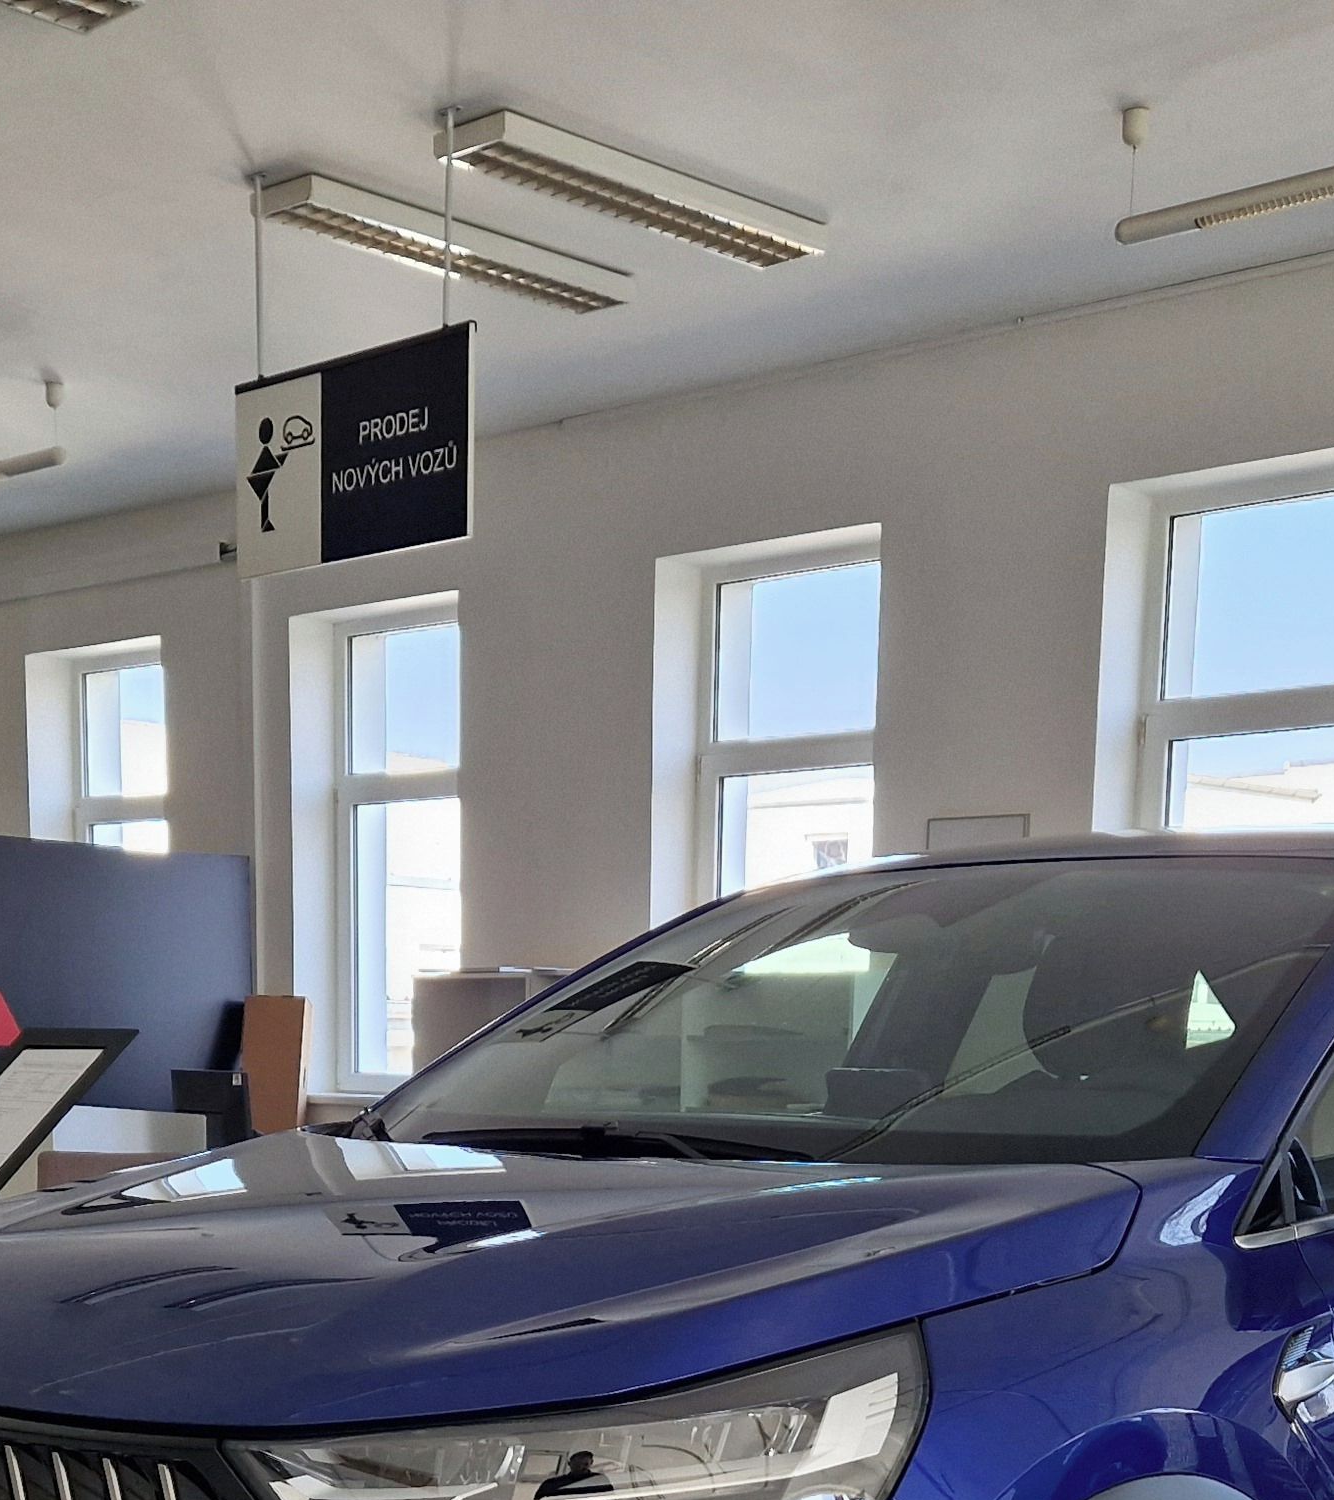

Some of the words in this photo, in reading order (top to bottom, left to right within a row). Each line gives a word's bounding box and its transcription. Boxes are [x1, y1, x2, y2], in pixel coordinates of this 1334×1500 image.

[359, 406, 430, 445] PRODEJ
[331, 457, 404, 494] NOVÝCH
[409, 440, 458, 477] VOZŮ
